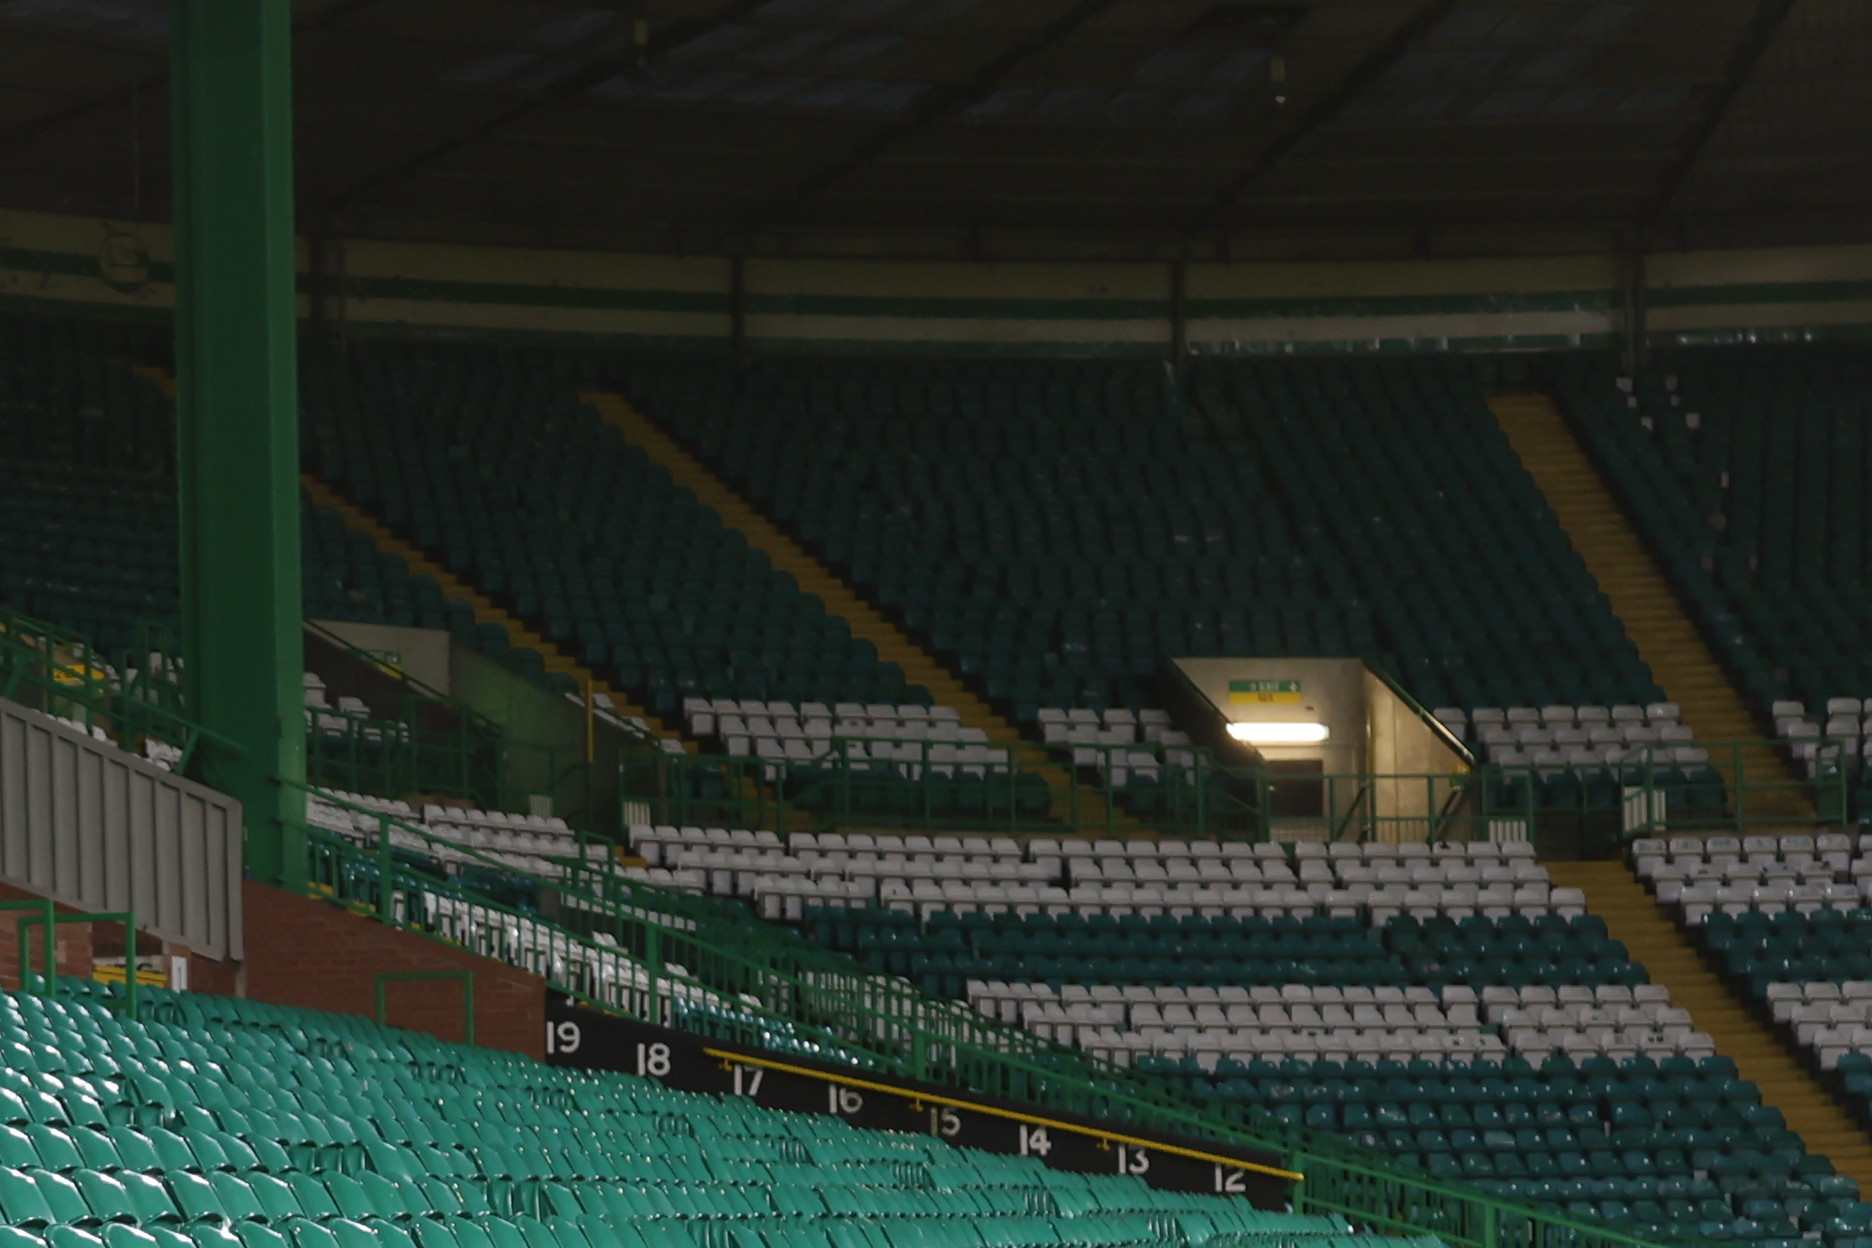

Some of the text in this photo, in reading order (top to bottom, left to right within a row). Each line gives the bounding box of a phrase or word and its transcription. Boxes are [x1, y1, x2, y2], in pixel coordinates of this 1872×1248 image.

[547, 1021, 580, 1053] 19
[637, 1042, 671, 1076] 18
[734, 1065, 763, 1096] 17
[829, 1084, 863, 1114] 16
[931, 1107, 961, 1137] 15
[1020, 1124, 1052, 1155] 14
[1118, 1143, 1150, 1174] 13
[1216, 1165, 1246, 1191] 12
